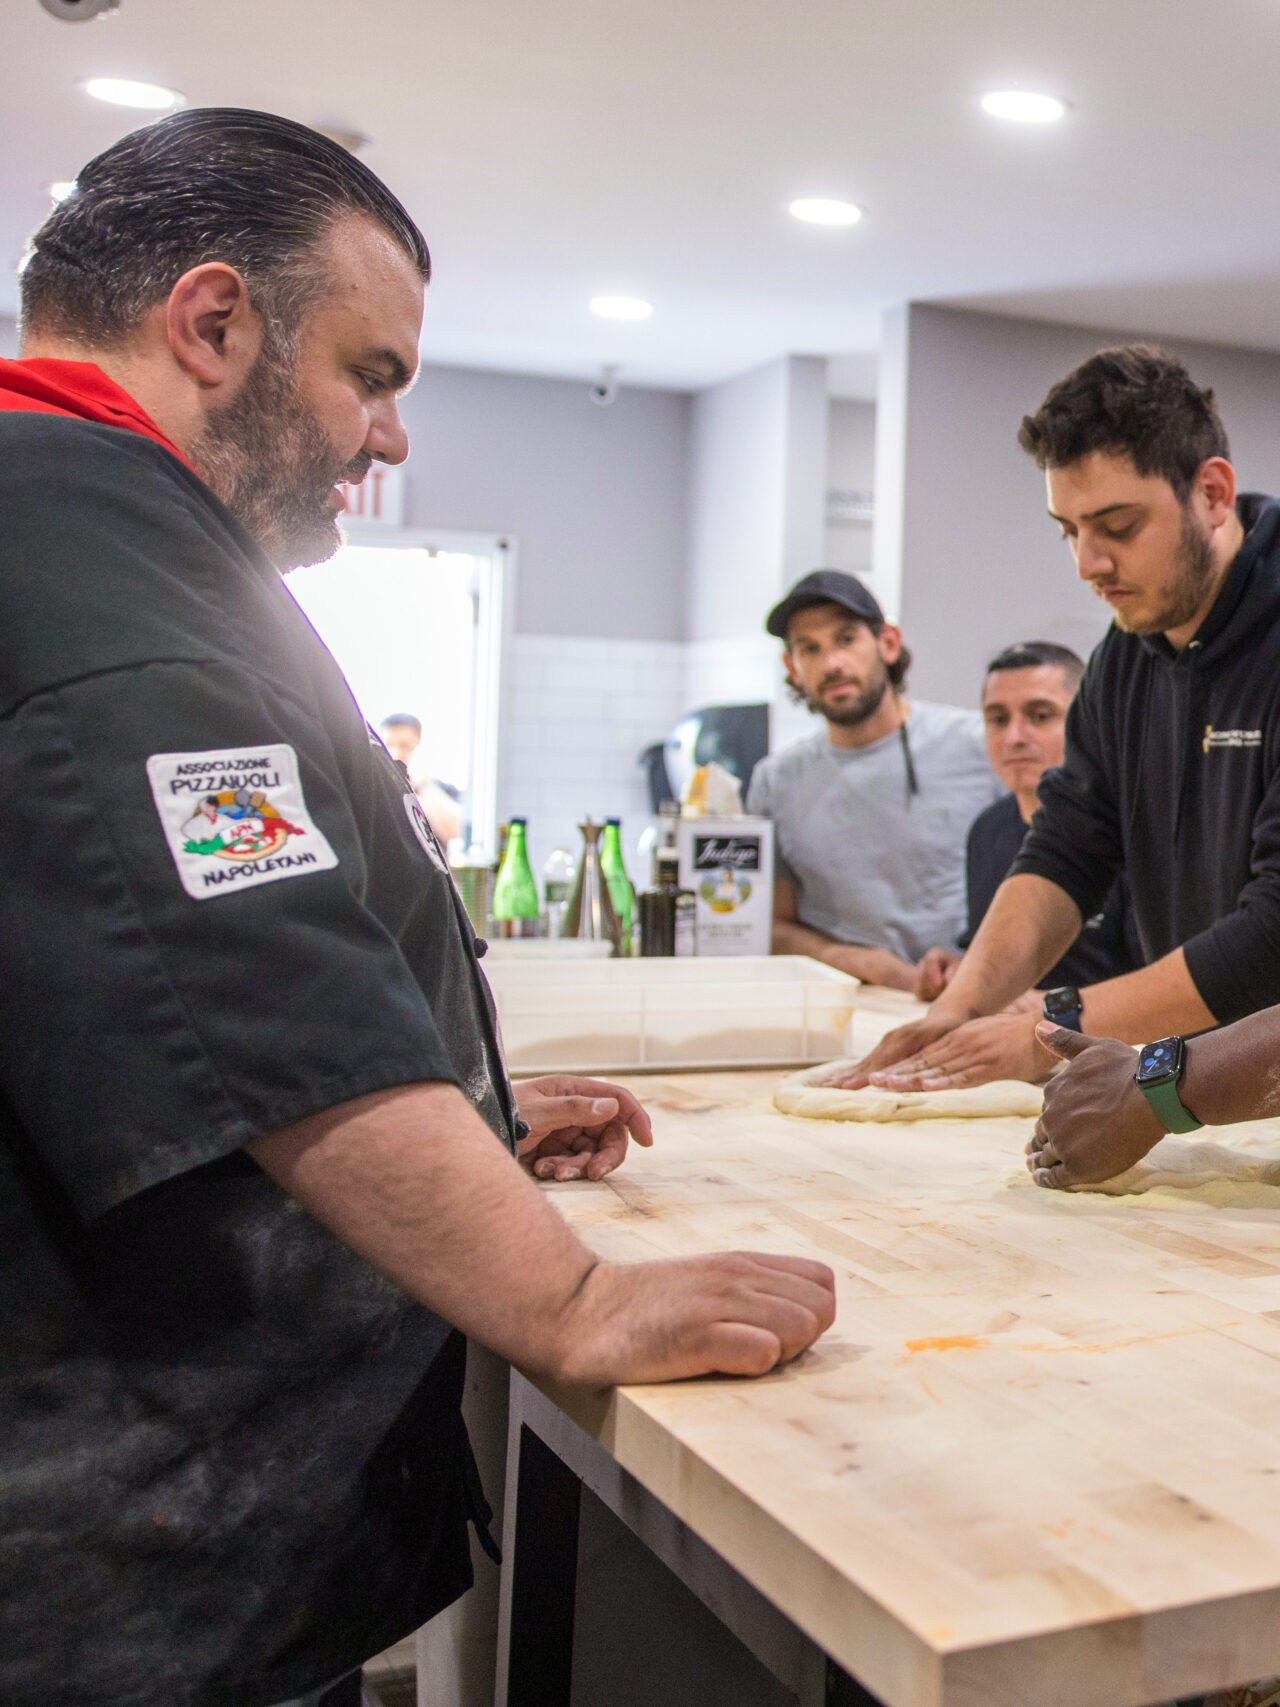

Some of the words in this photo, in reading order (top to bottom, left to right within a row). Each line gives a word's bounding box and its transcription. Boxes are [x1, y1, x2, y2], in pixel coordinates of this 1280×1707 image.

[176, 757, 271, 776] ASSOCIAZIONE
[170, 772, 281, 794] PIZZAIUOLI
[202, 852, 317, 887] NAPOLETANI
